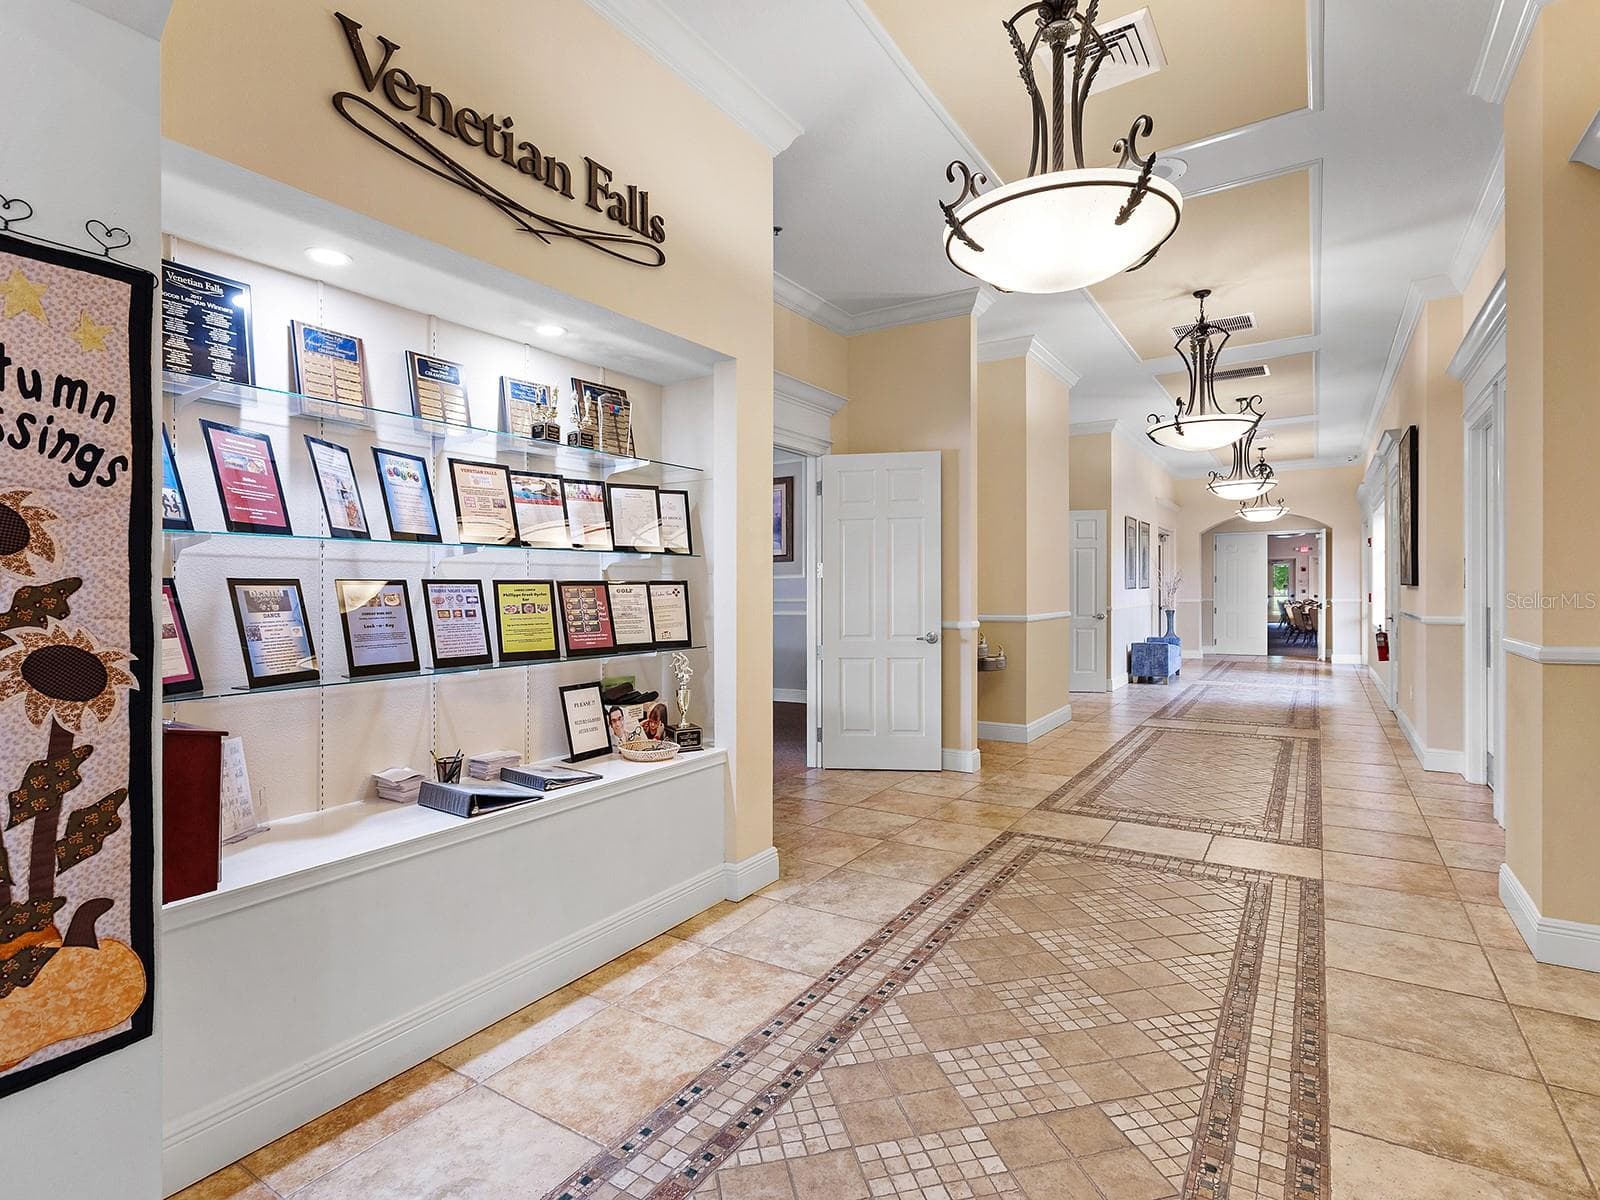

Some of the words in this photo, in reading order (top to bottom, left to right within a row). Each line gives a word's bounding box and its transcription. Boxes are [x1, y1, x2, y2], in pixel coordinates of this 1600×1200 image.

[333, 11, 575, 201] Venetian
[583, 155, 666, 245] Falls
[165, 270, 204, 289] Venetian
[204, 281, 224, 296] Falls
[180, 295, 206, 307] League
[206, 301, 234, 314] Winners
